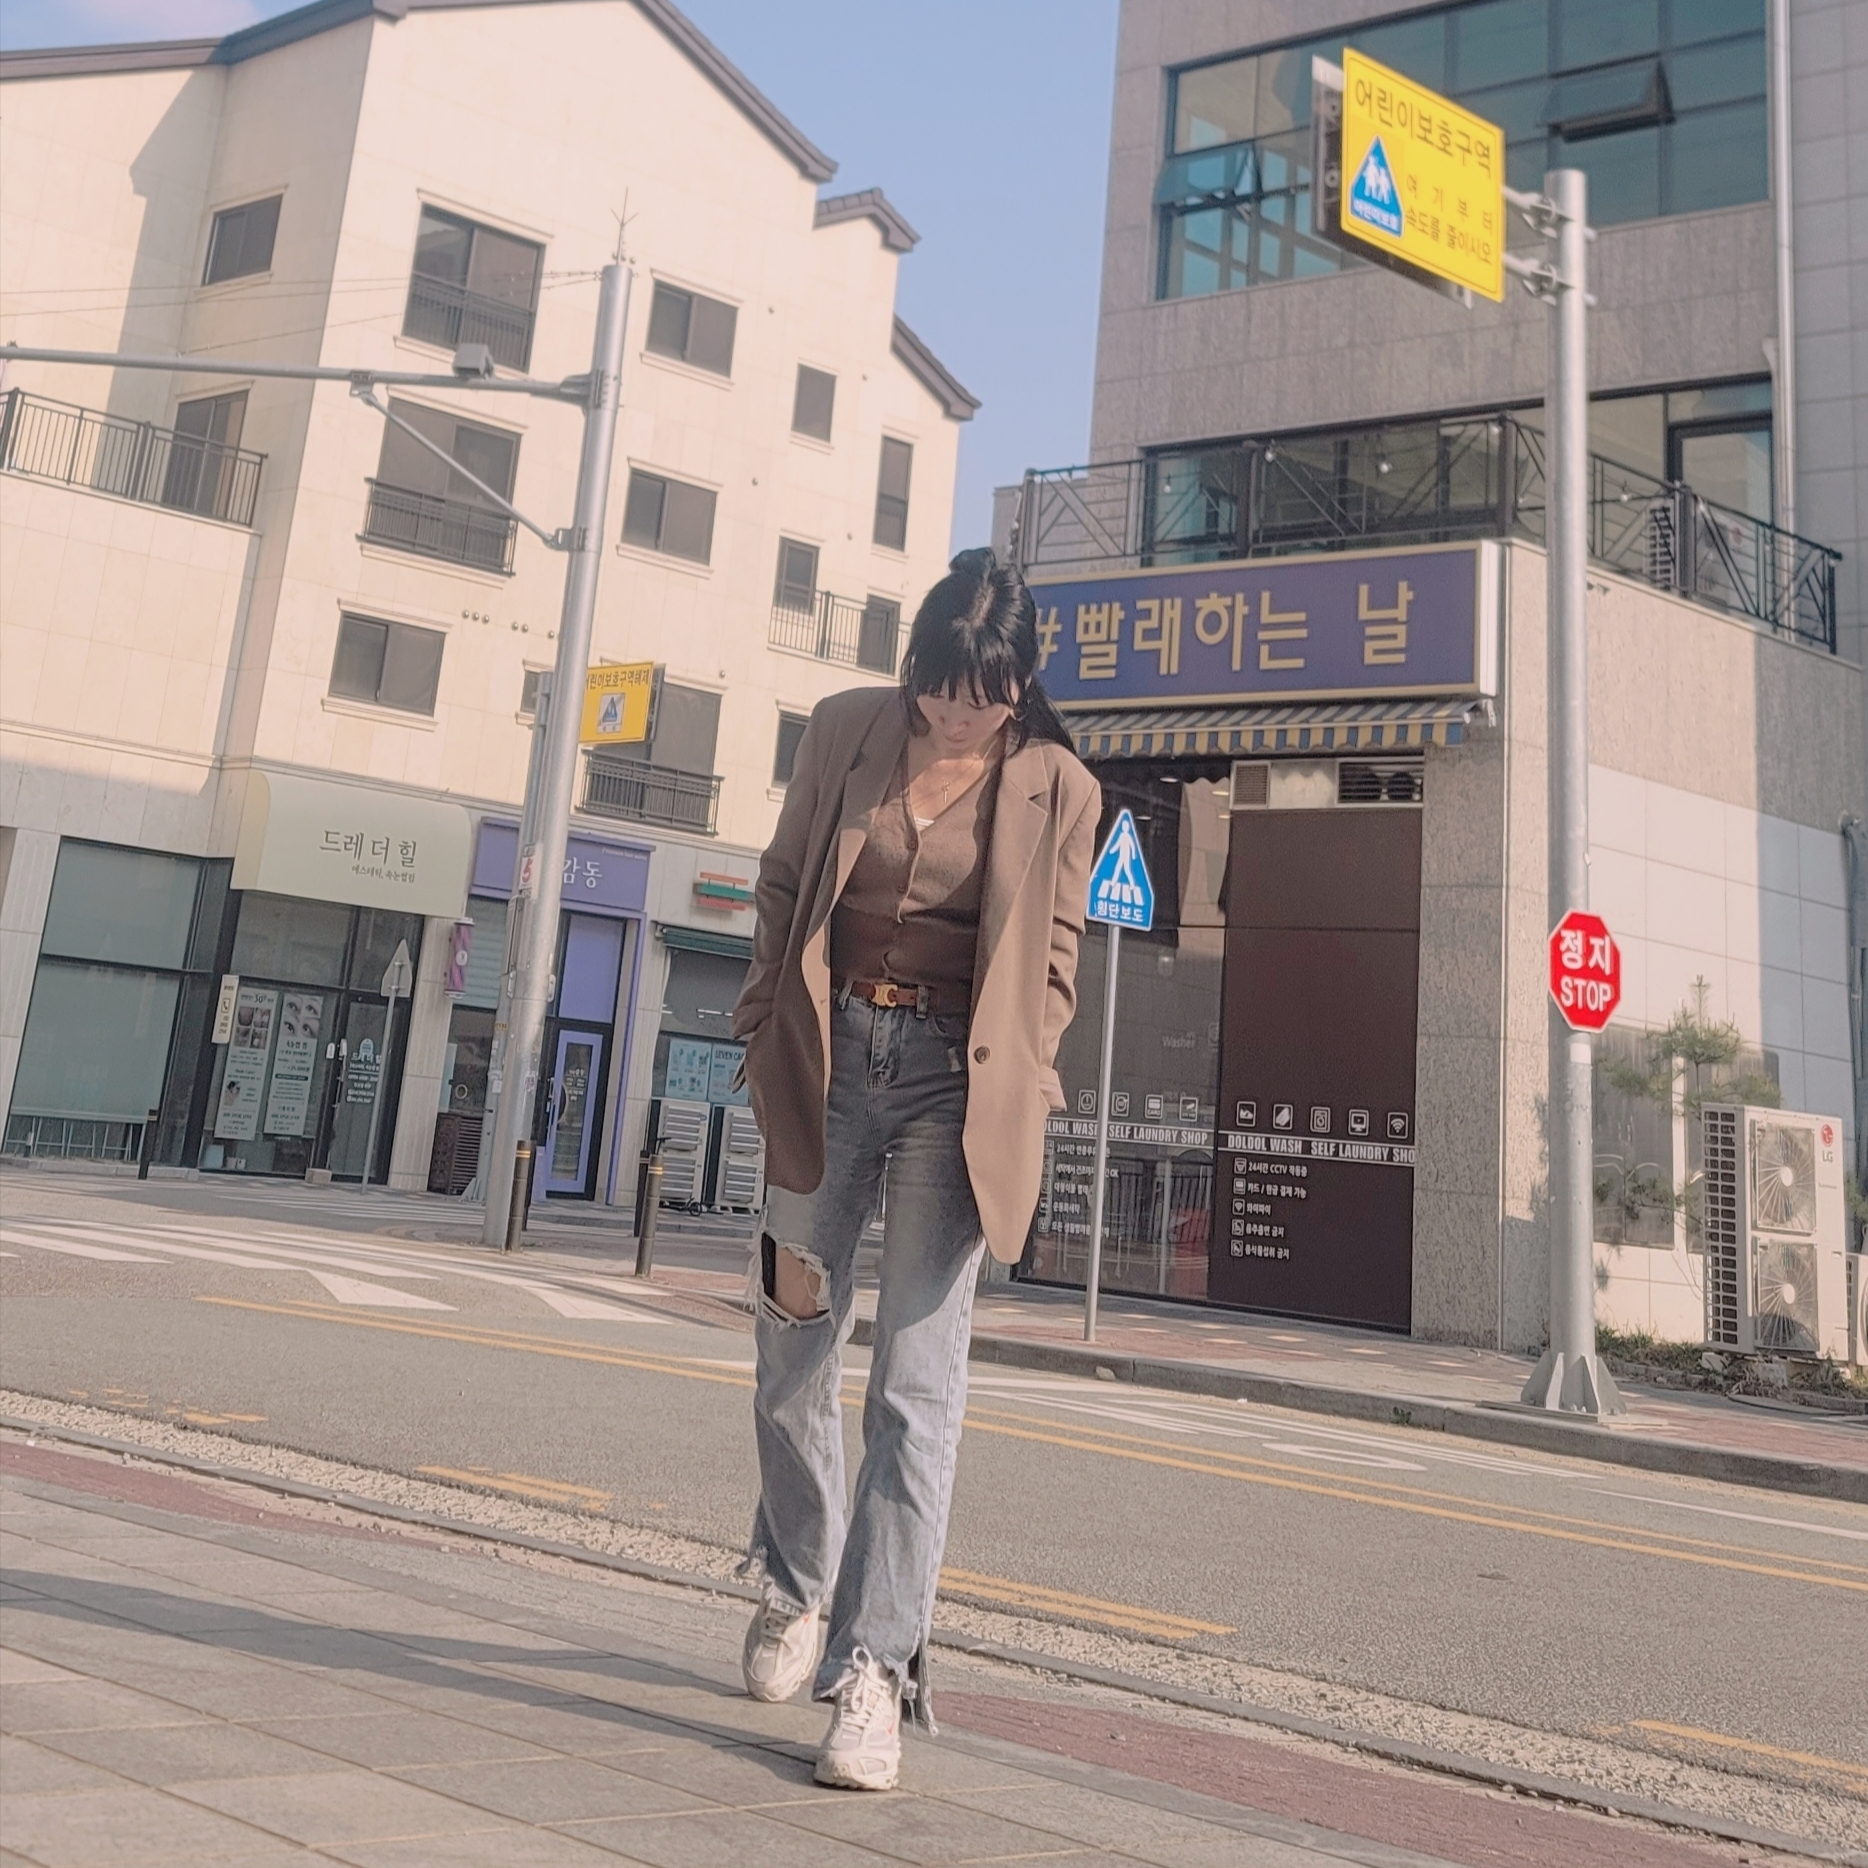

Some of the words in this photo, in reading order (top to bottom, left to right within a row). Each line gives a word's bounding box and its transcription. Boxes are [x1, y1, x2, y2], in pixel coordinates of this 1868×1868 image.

[1355, 78, 1491, 180] 어린이보호구역
[1405, 206, 1440, 243] 속도를
[1447, 223, 1492, 265] 줄이시오
[1357, 580, 1414, 665] 날
[319, 829, 365, 861] 드레
[371, 836, 390, 865] 더
[398, 840, 417, 868] 힐
[563, 856, 603, 889] 감동
[1097, 899, 1144, 923] 횡단보도
[1559, 929, 1612, 976] 정지
[1560, 975, 1613, 1012] STOP
[1108, 1124, 1132, 1139] SELF
[1133, 1126, 1179, 1144] LAUNDRY
[1180, 1130, 1208, 1146] SHOP
[1227, 1134, 1267, 1151] DOLDOL
[1269, 1138, 1303, 1154] WASH
[1311, 1140, 1336, 1156] SELF
[1338, 1143, 1389, 1161] LAUNDRY
[1392, 1148, 1415, 1164] SHO
[1248, 1161, 1269, 1174] 24시간
[1269, 1163, 1288, 1175] CCTV
[1822, 1150, 1833, 1163] LG
[1247, 1182, 1260, 1194] 카드
[1271, 1225, 1285, 1238] 금지
[1276, 1247, 1290, 1260] 금지
